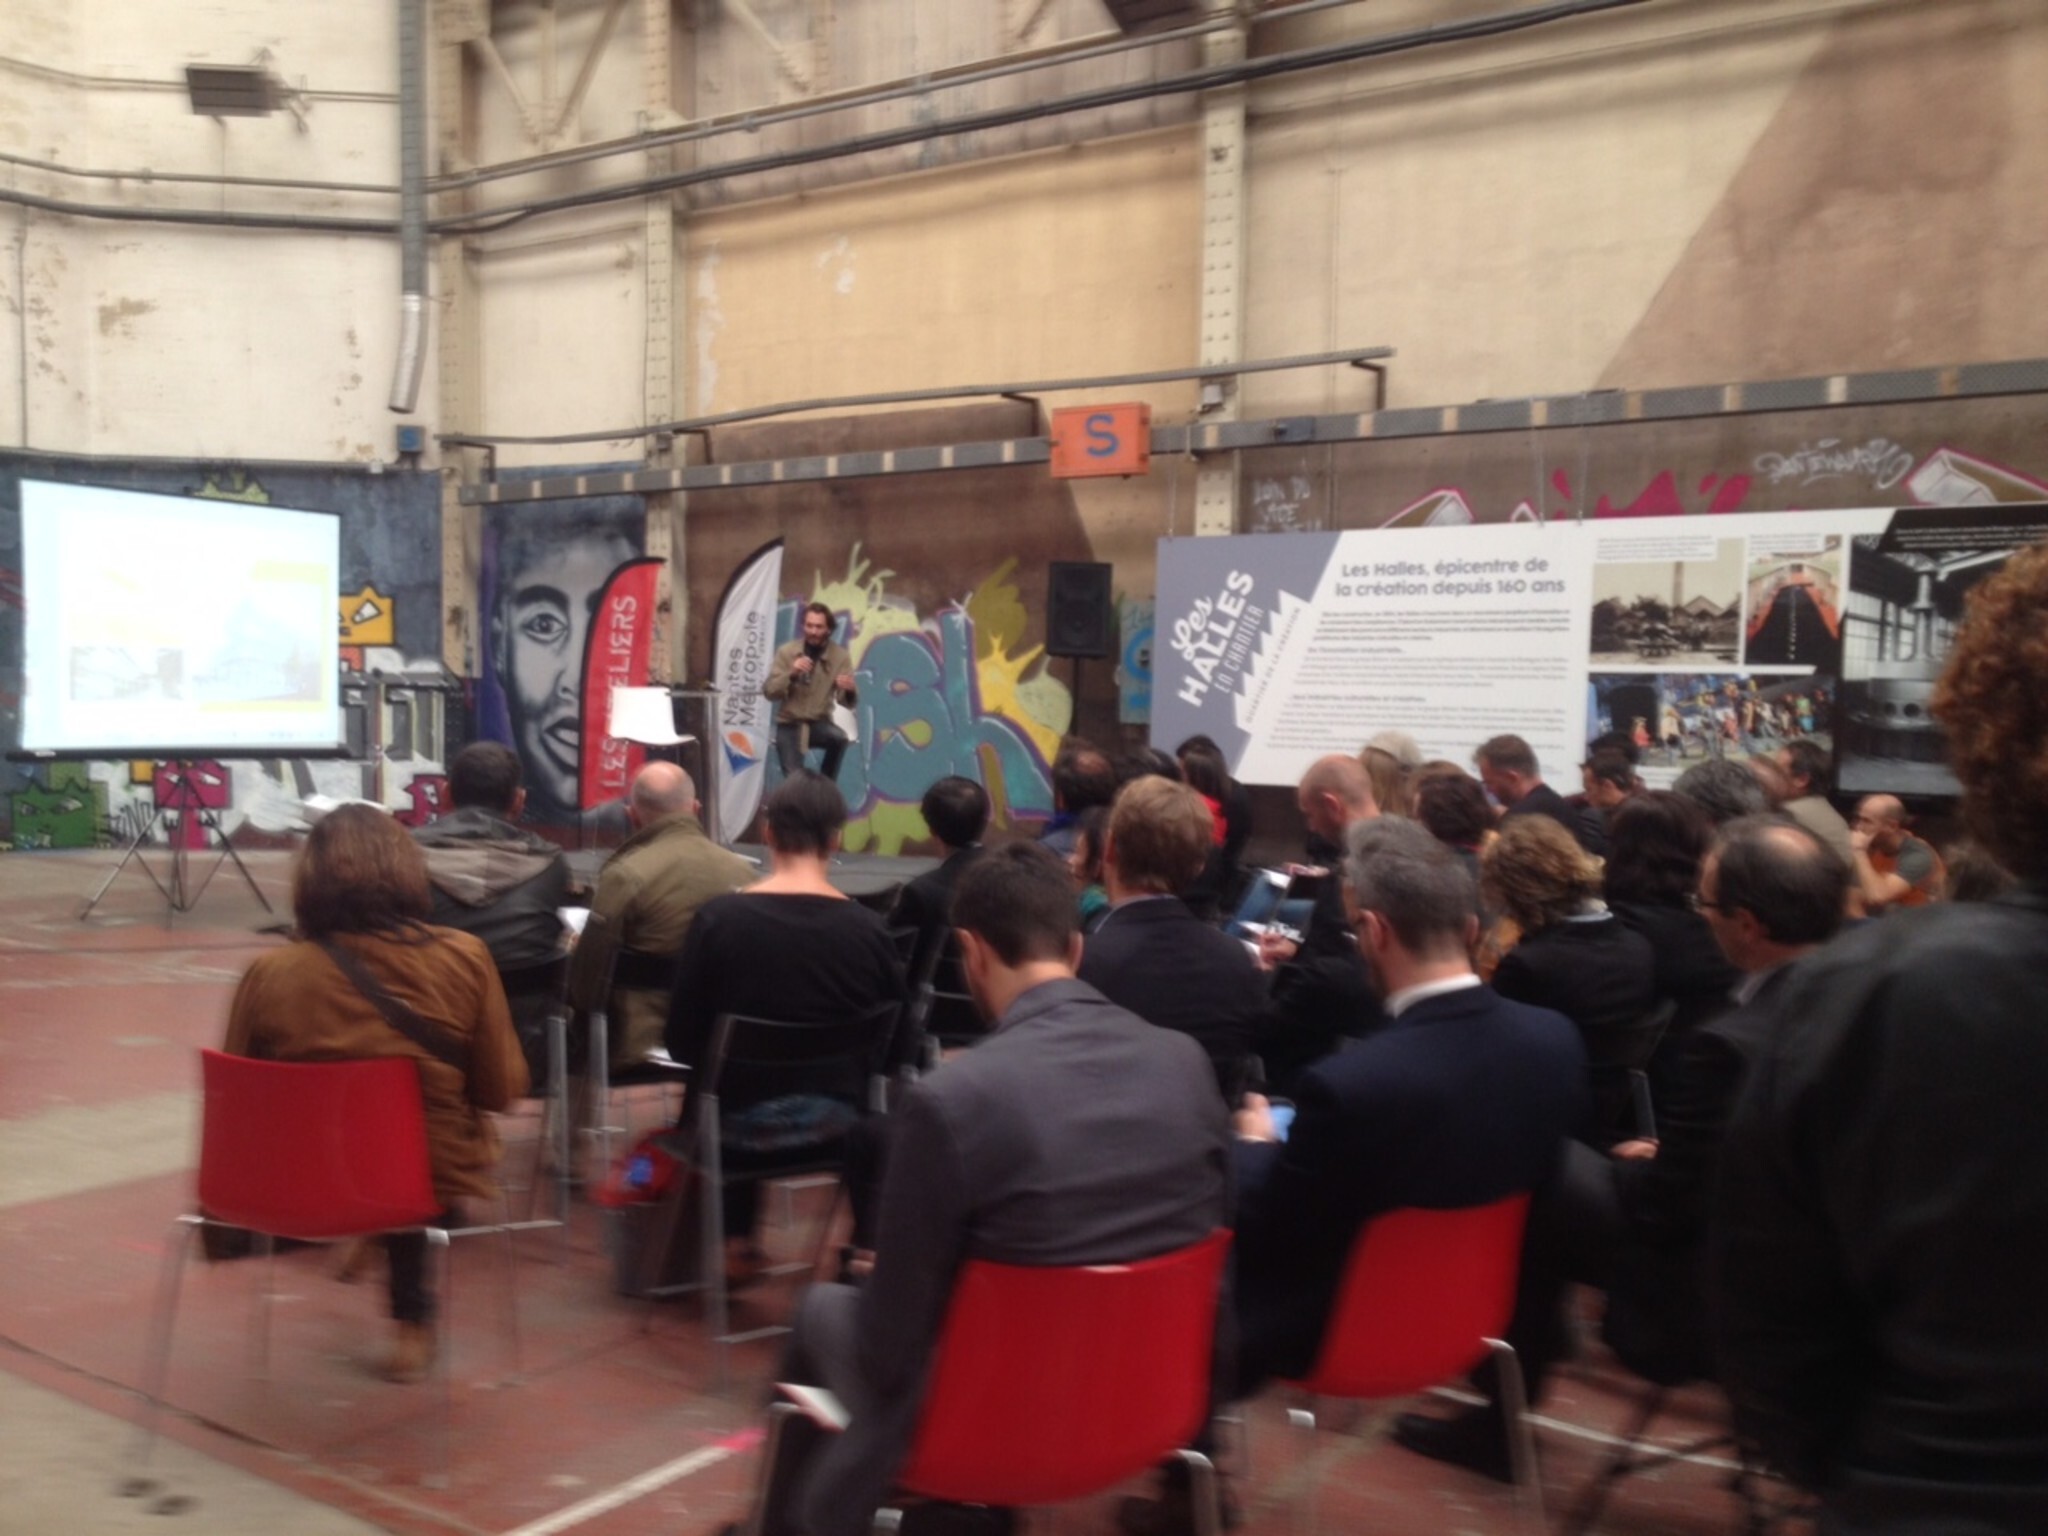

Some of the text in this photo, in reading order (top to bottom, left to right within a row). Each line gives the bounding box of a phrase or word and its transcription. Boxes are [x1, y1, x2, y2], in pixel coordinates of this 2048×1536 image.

[1085, 413, 1119, 457] S
[1335, 579, 1565, 598] la création depuis 160 ans
[1341, 557, 1549, 578] Les Halles, épicentre de
[1169, 596, 1213, 662] Les
[1177, 569, 1254, 708] HALLES
[1223, 604, 1264, 672] CHANTIER
[604, 594, 637, 734] ELIERS
[724, 647, 743, 726] Nantes
